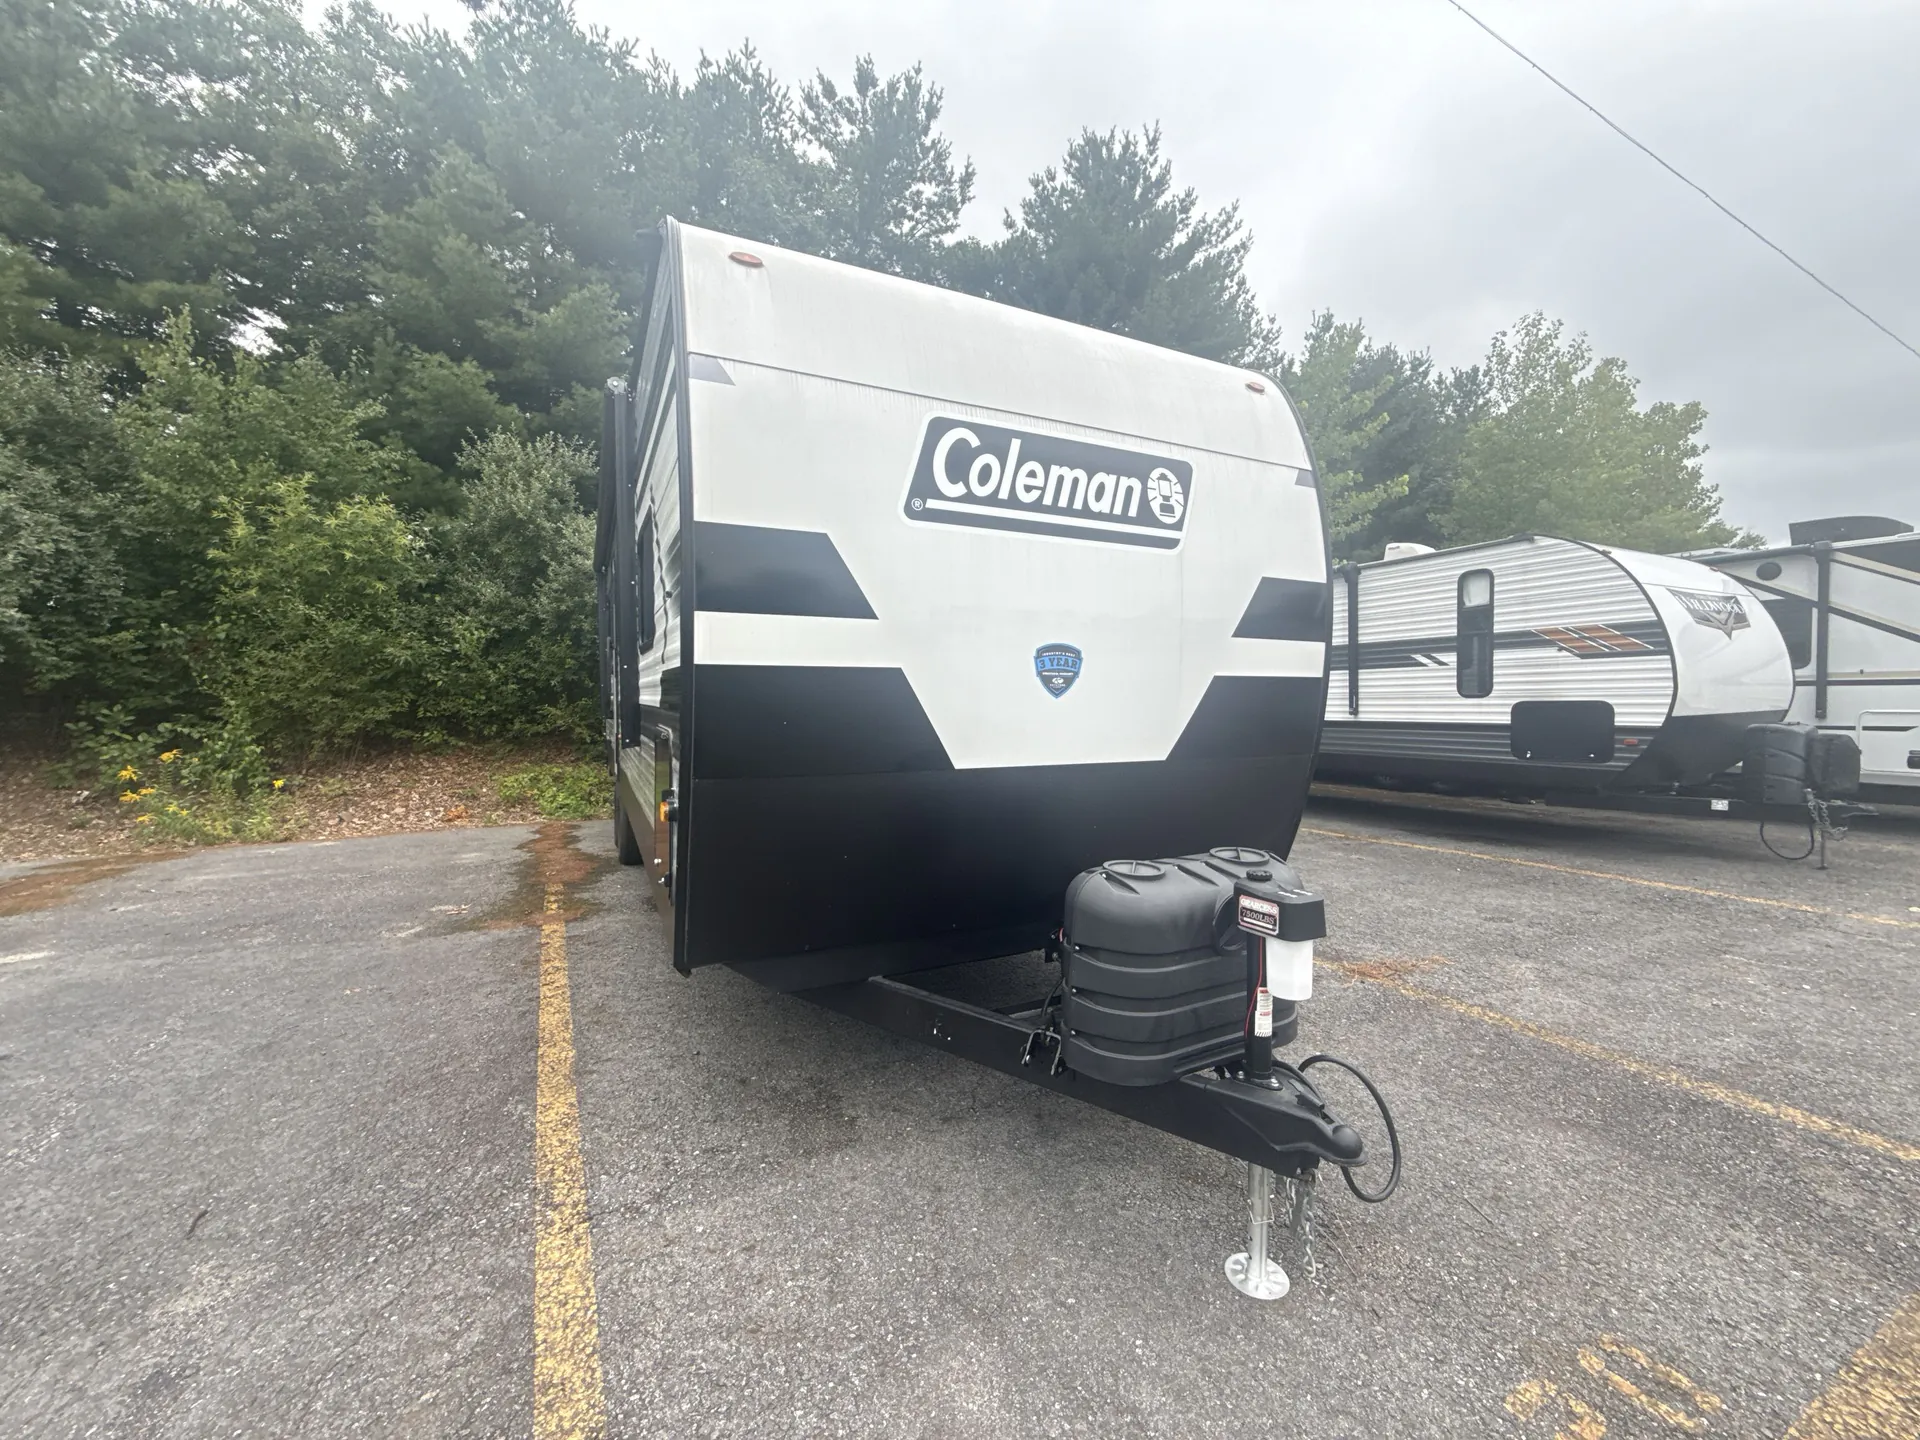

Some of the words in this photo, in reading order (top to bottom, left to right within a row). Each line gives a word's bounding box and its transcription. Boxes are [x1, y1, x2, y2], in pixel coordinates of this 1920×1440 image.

[933, 427, 1142, 518] Coleman
[1048, 657, 1078, 670] YEAR
[1242, 909, 1275, 924] 7500LBS
